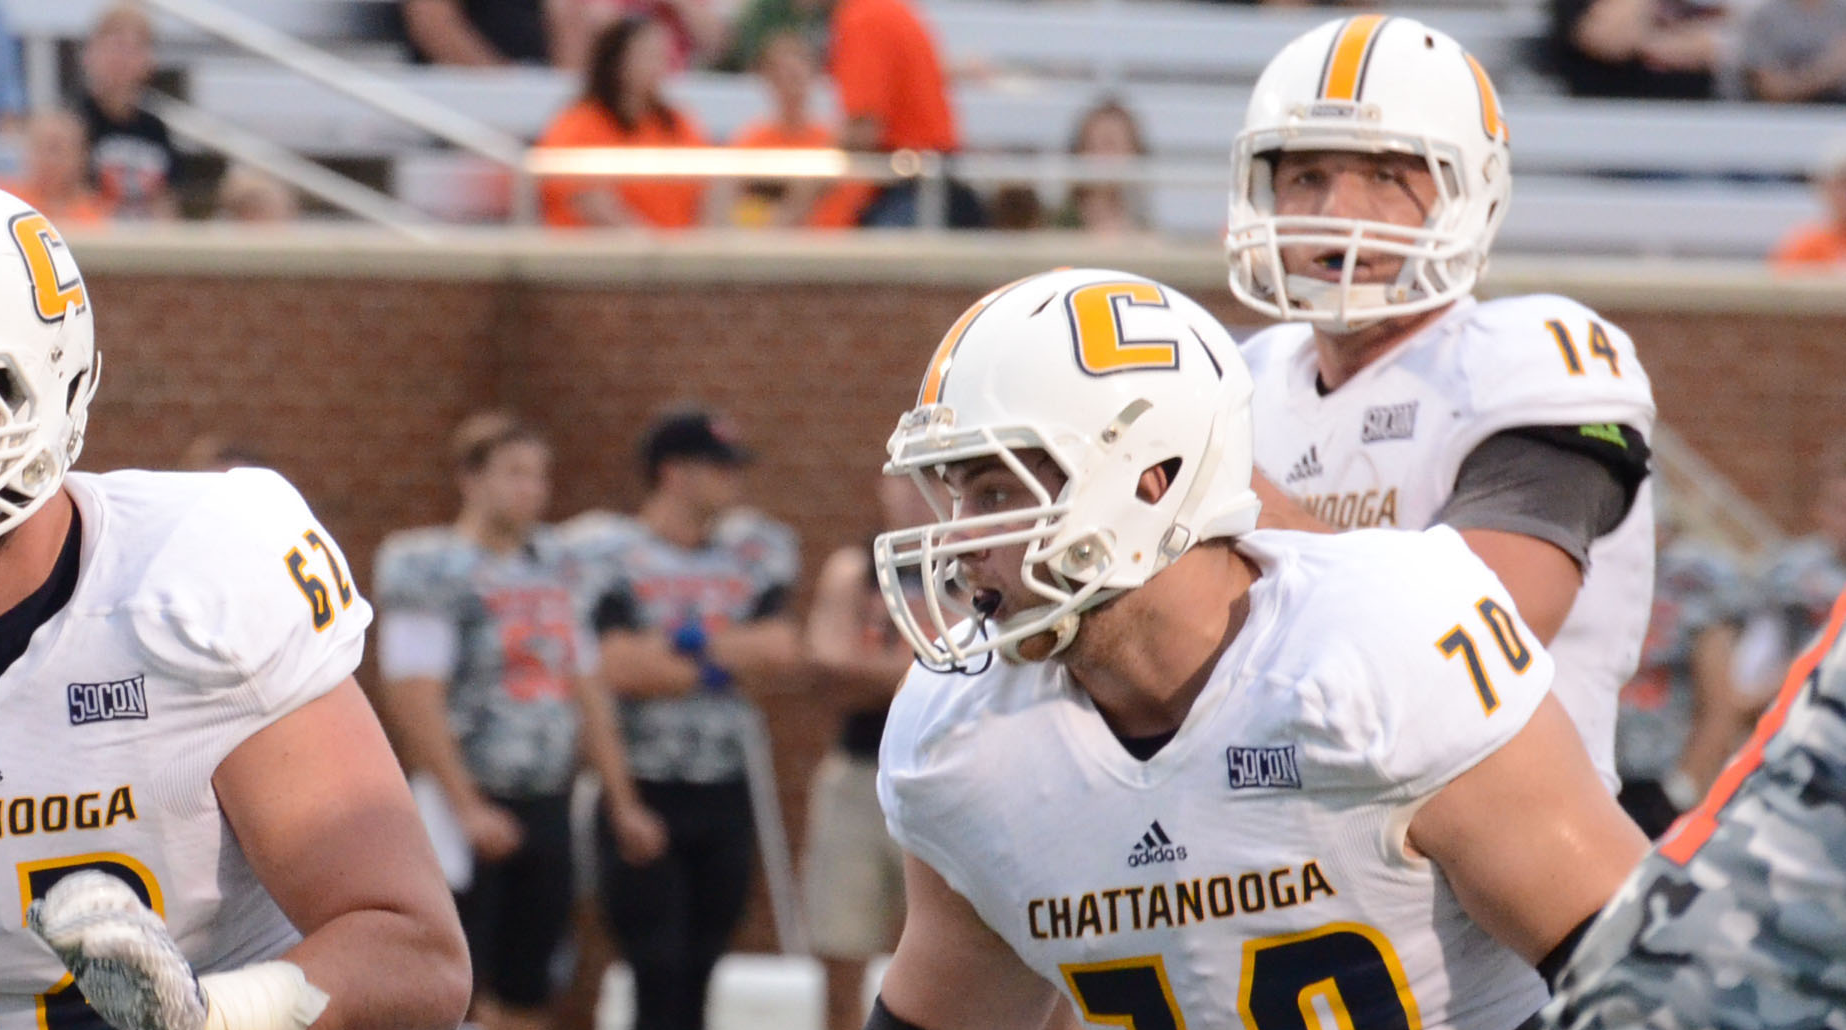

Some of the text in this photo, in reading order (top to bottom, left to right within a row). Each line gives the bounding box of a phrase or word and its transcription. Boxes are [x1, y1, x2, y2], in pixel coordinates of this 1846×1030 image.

[1064, 281, 1180, 377] C
[1545, 318, 1622, 378] 14
[283, 528, 353, 633] 62
[1434, 595, 1534, 718] 70
[1027, 858, 1337, 940] CHATTANOOGA
[1128, 845, 1187, 867] adidas
